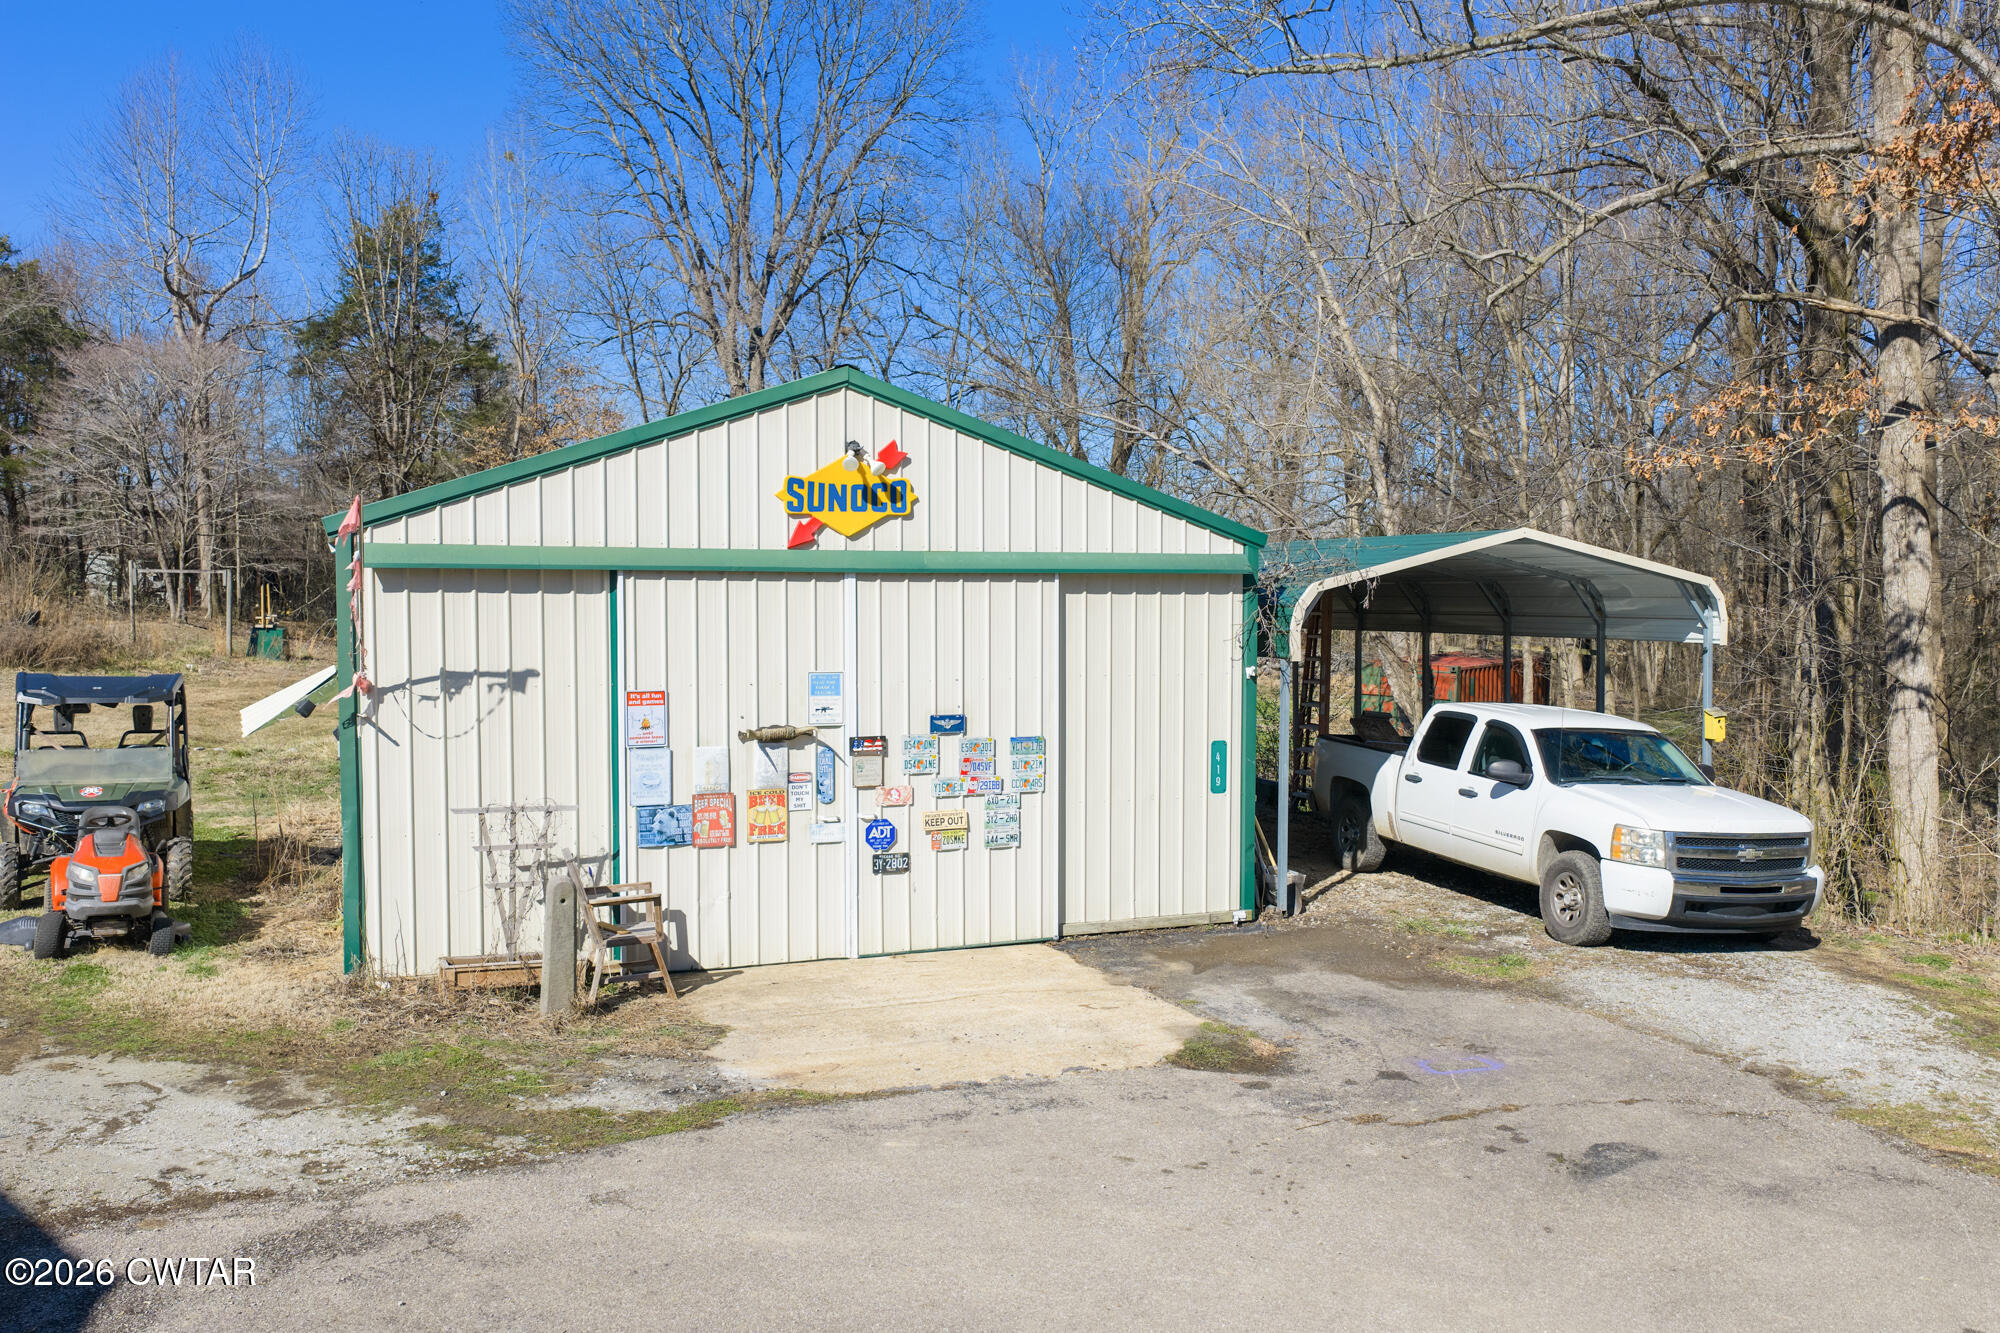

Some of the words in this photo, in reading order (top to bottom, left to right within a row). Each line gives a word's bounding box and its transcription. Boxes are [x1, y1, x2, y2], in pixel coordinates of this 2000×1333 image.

[787, 477, 907, 513] SUNOCO
[852, 738, 883, 752] USA
[694, 799, 708, 813] BEER
[749, 794, 785, 809] BEER
[749, 821, 785, 836] FREE
[924, 817, 945, 827] KEEP
[947, 816, 964, 826] OUT
[868, 825, 893, 839] ADT
[1495, 829, 1525, 841] SILVERADO
